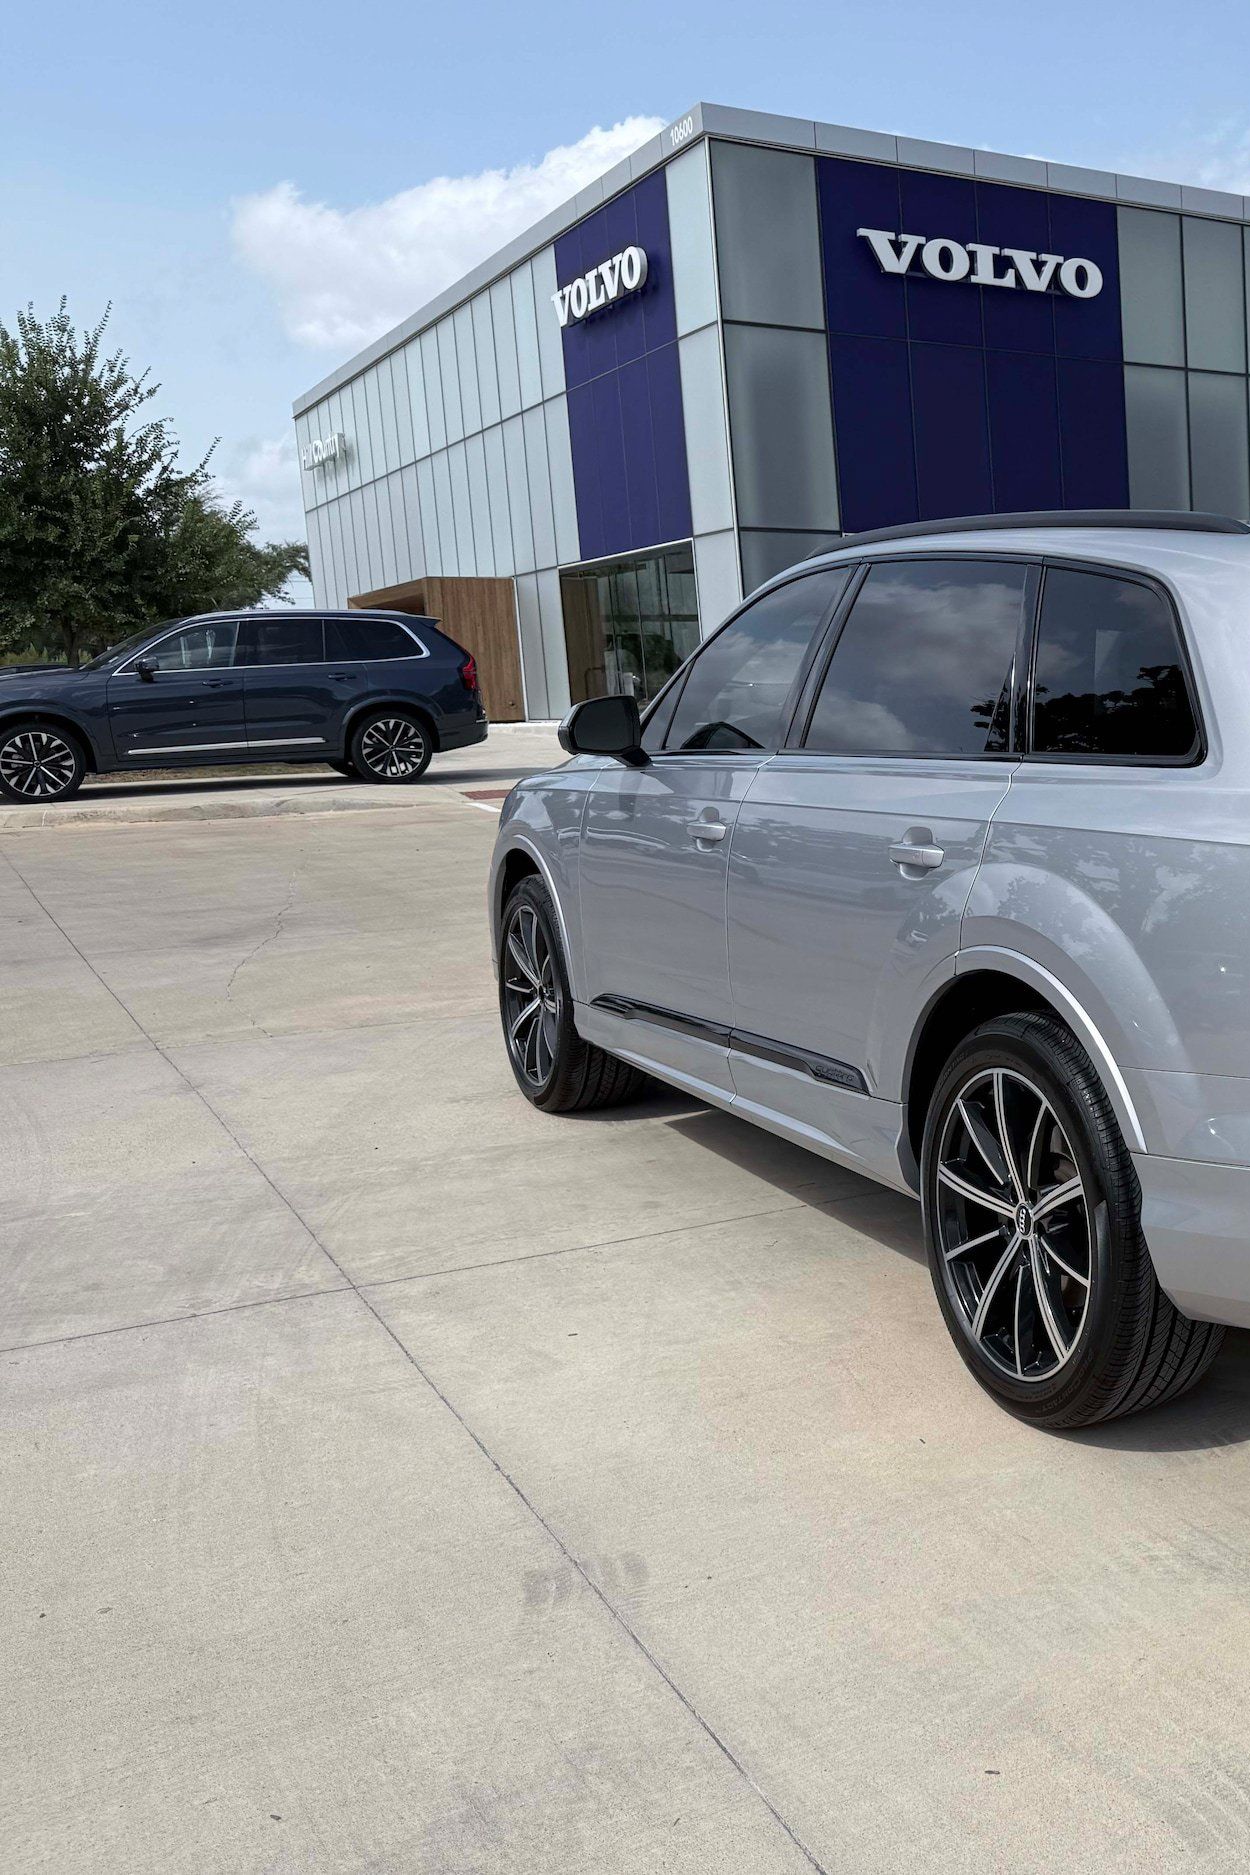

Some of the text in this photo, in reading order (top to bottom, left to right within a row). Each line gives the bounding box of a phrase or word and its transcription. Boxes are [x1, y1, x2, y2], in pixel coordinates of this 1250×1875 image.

[670, 116, 693, 146] 10600
[551, 246, 647, 328] VOLVO
[857, 228, 1104, 299] VOLVO
